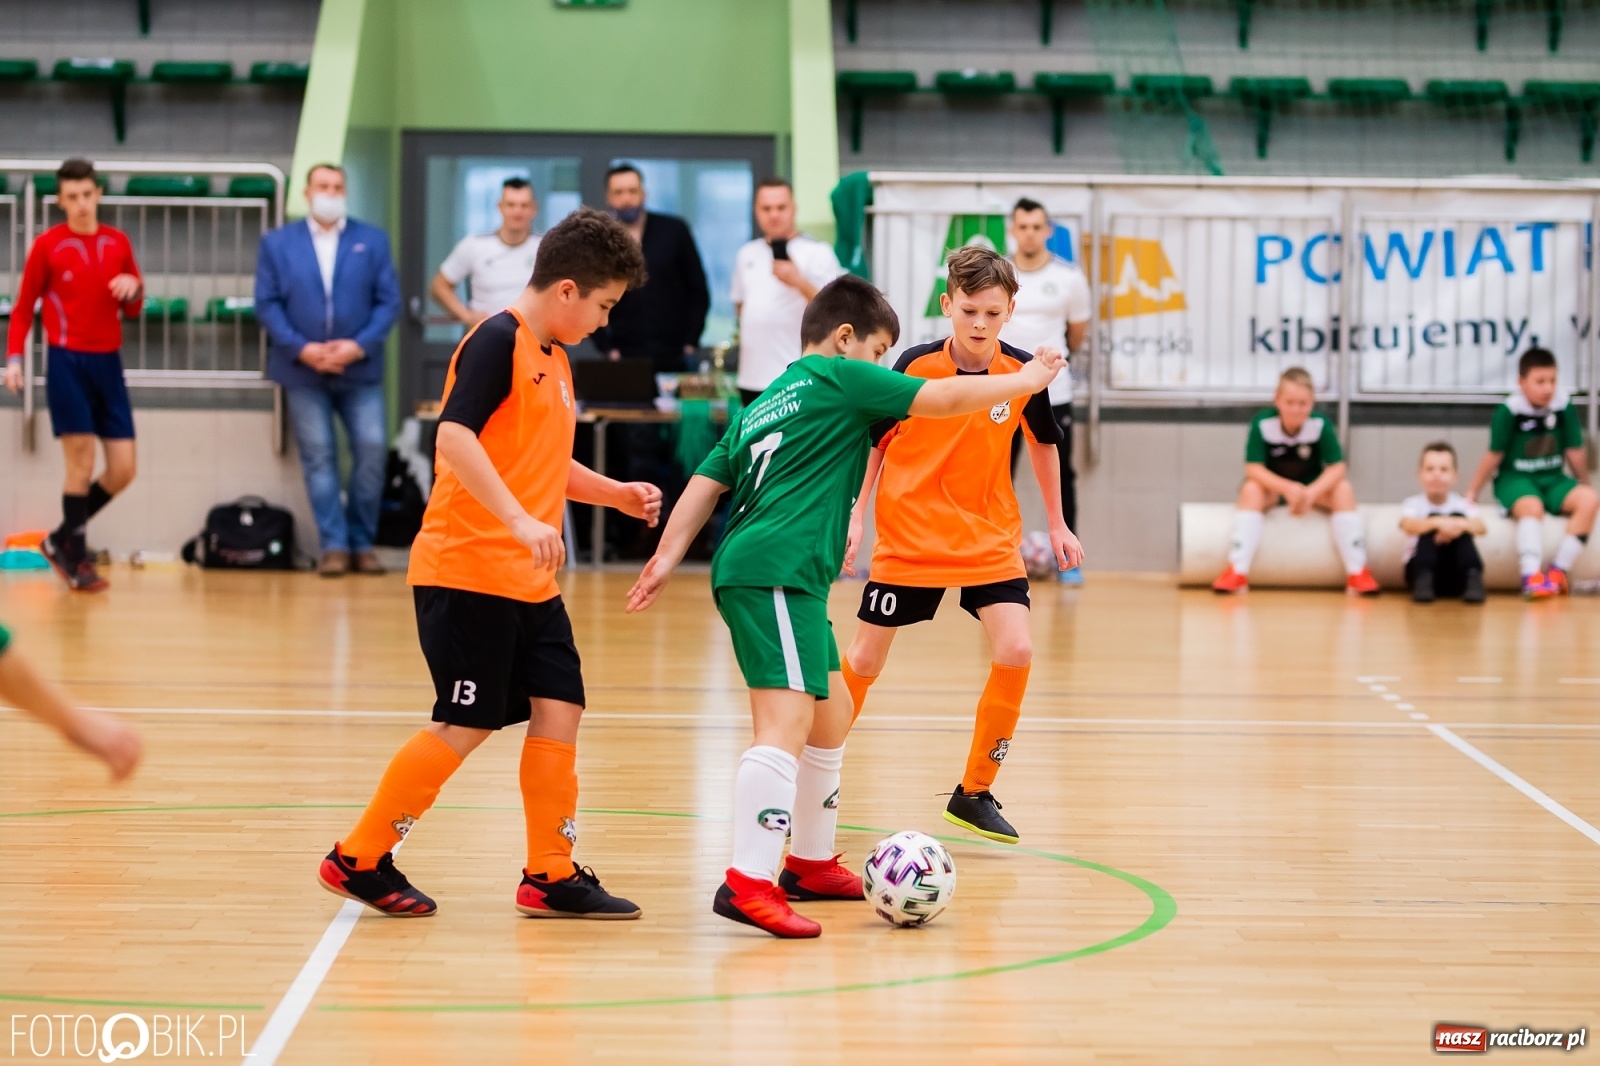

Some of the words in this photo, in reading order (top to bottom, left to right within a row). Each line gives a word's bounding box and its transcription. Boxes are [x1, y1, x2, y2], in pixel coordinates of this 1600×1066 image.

[1256, 222, 1557, 285] POWIAT
[745, 431, 783, 498] 7
[869, 588, 897, 616] 10
[451, 679, 477, 706] 13
